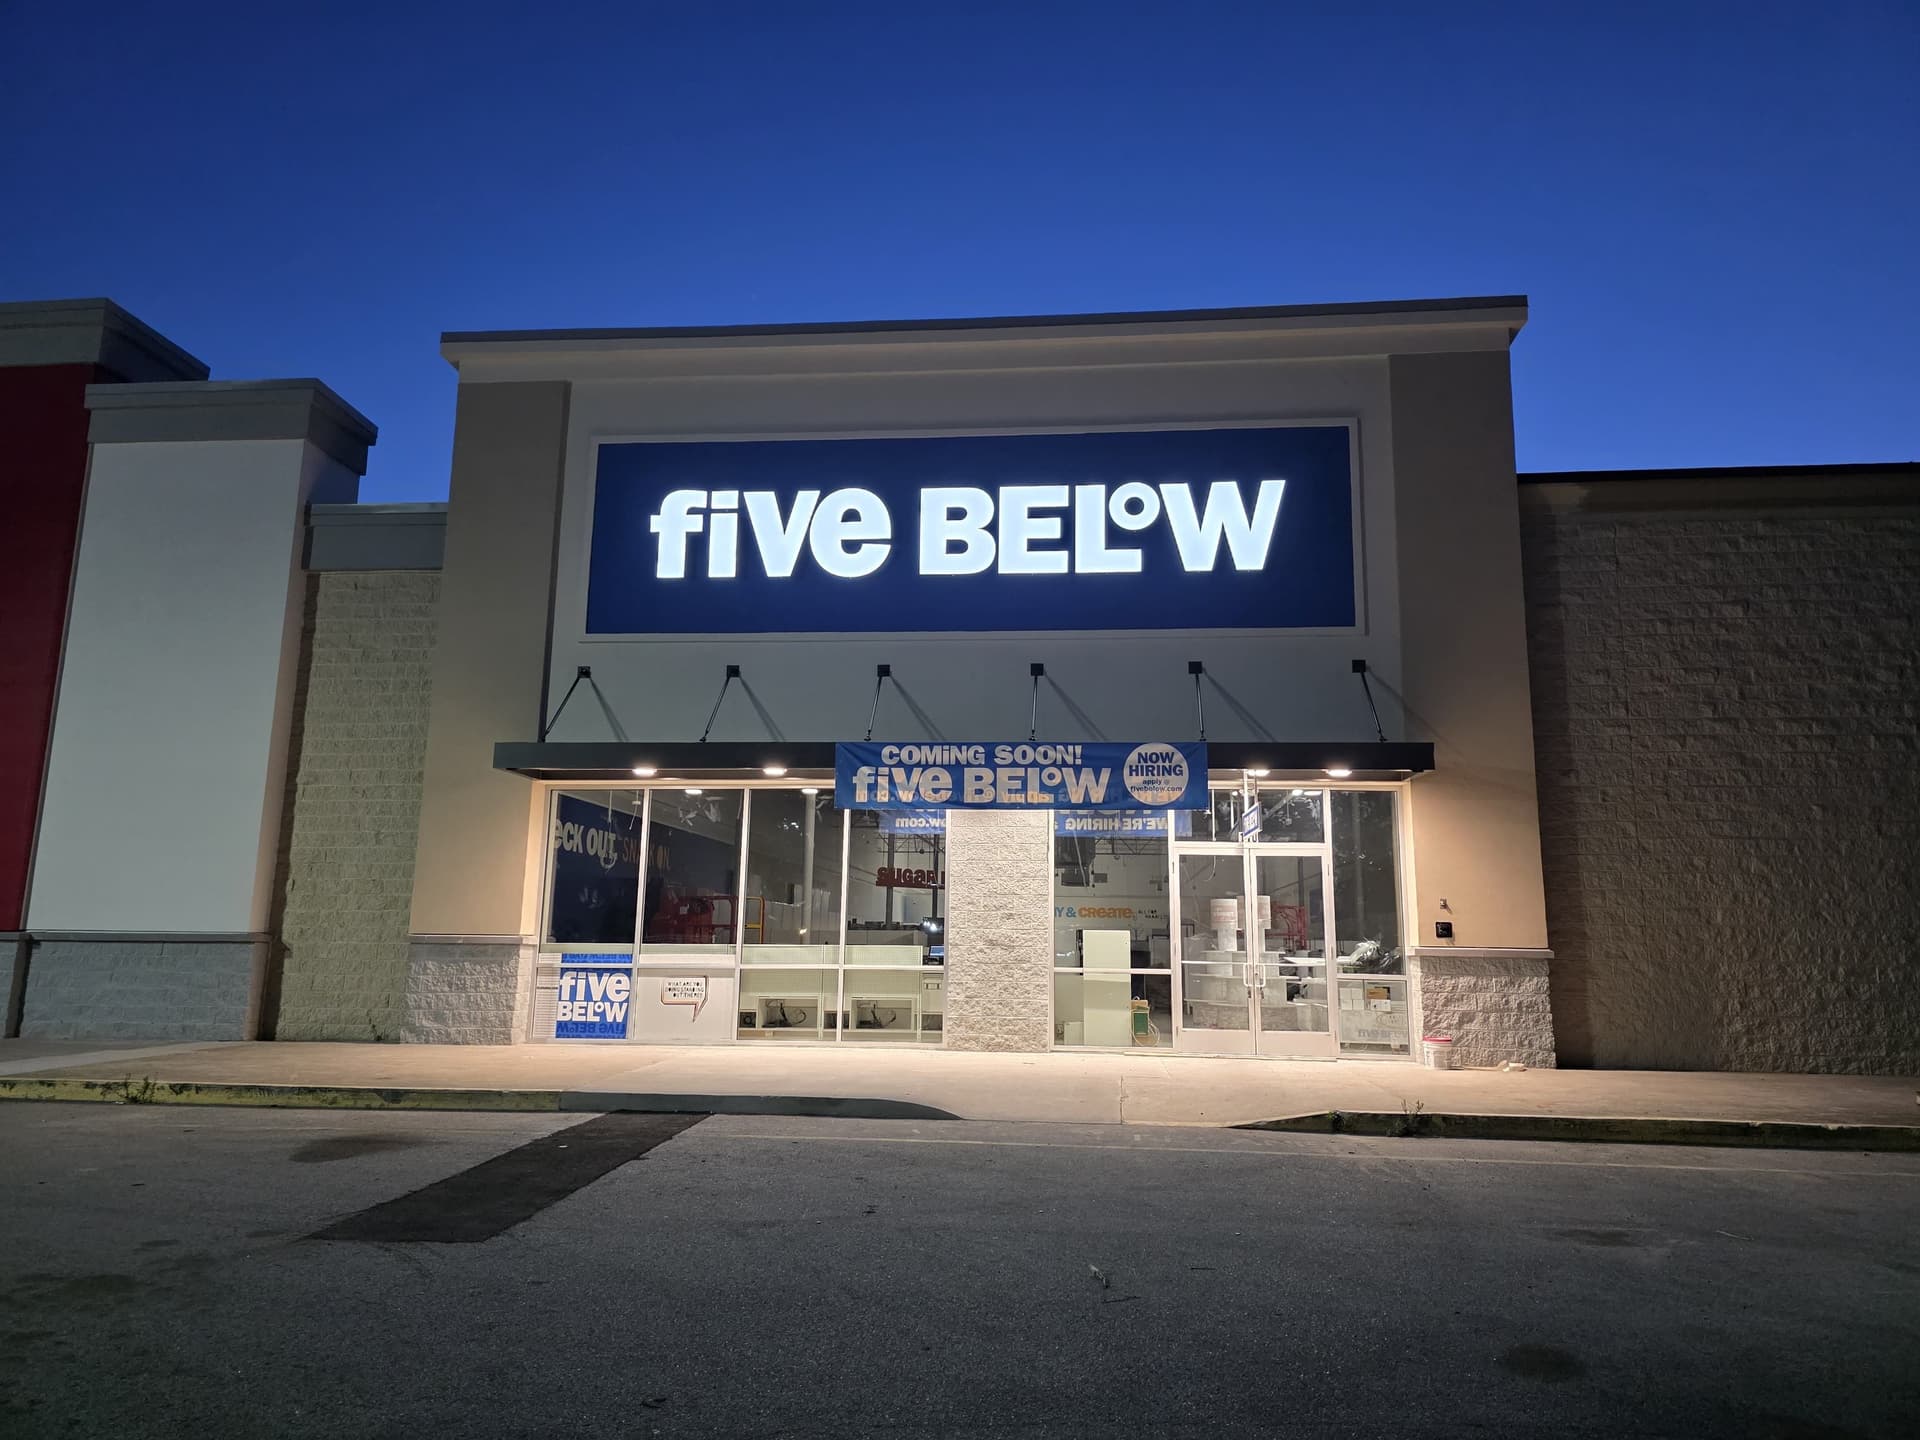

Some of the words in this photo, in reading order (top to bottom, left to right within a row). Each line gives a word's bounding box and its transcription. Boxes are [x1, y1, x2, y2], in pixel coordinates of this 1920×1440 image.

[650, 487, 892, 578] five
[919, 479, 1286, 575] BELOW
[993, 744, 1082, 765] SOON!
[1137, 751, 1175, 764] NOW
[1128, 764, 1184, 777] HIRING
[852, 766, 953, 803] five
[963, 766, 1112, 804] BELOW
[1142, 777, 1162, 786] apply
[1065, 906, 1077, 918] &
[559, 971, 630, 1002] five
[557, 1001, 628, 1023] BELOW
